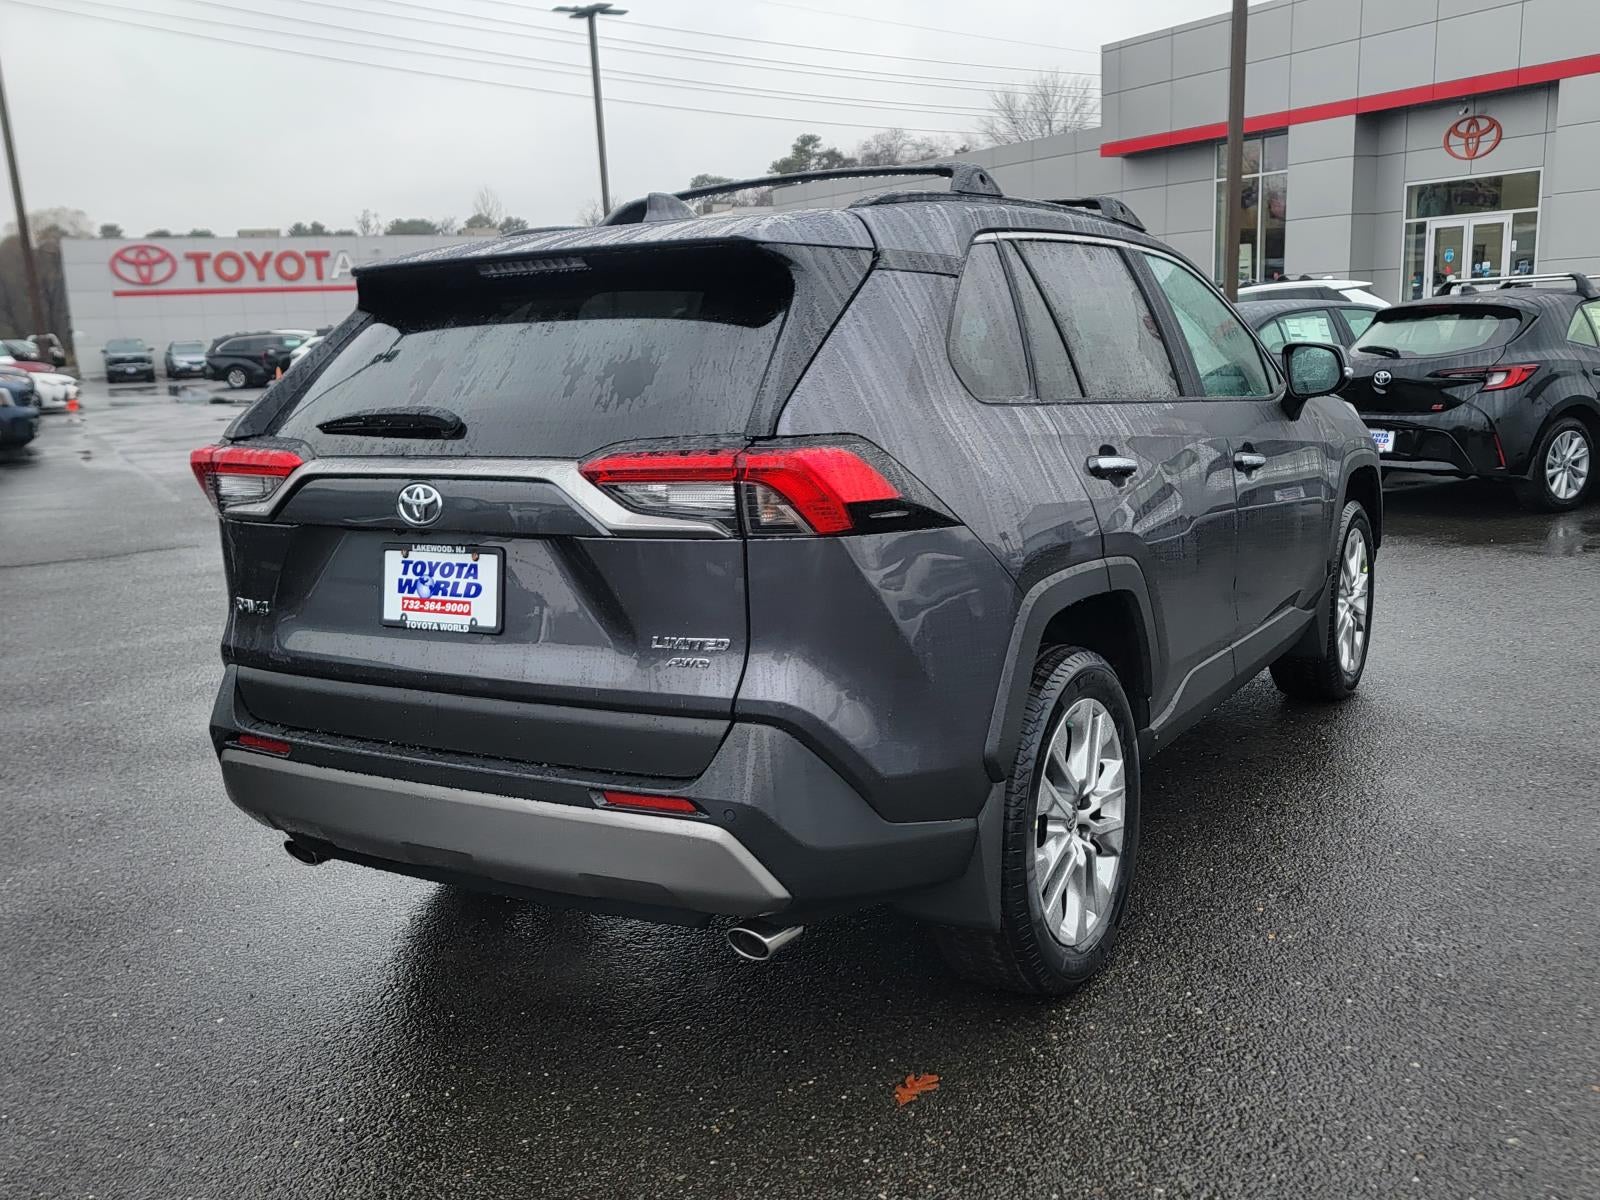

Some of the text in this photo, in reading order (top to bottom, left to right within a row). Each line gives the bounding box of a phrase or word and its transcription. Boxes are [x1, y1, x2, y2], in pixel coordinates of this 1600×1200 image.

[185, 249, 353, 283] TOYOTA
[401, 559, 479, 580] TOYOTA
[403, 599, 470, 614] 732-364-9000
[406, 621, 469, 632] TOYOTA WORLD
[650, 635, 731, 652] LIMITED
